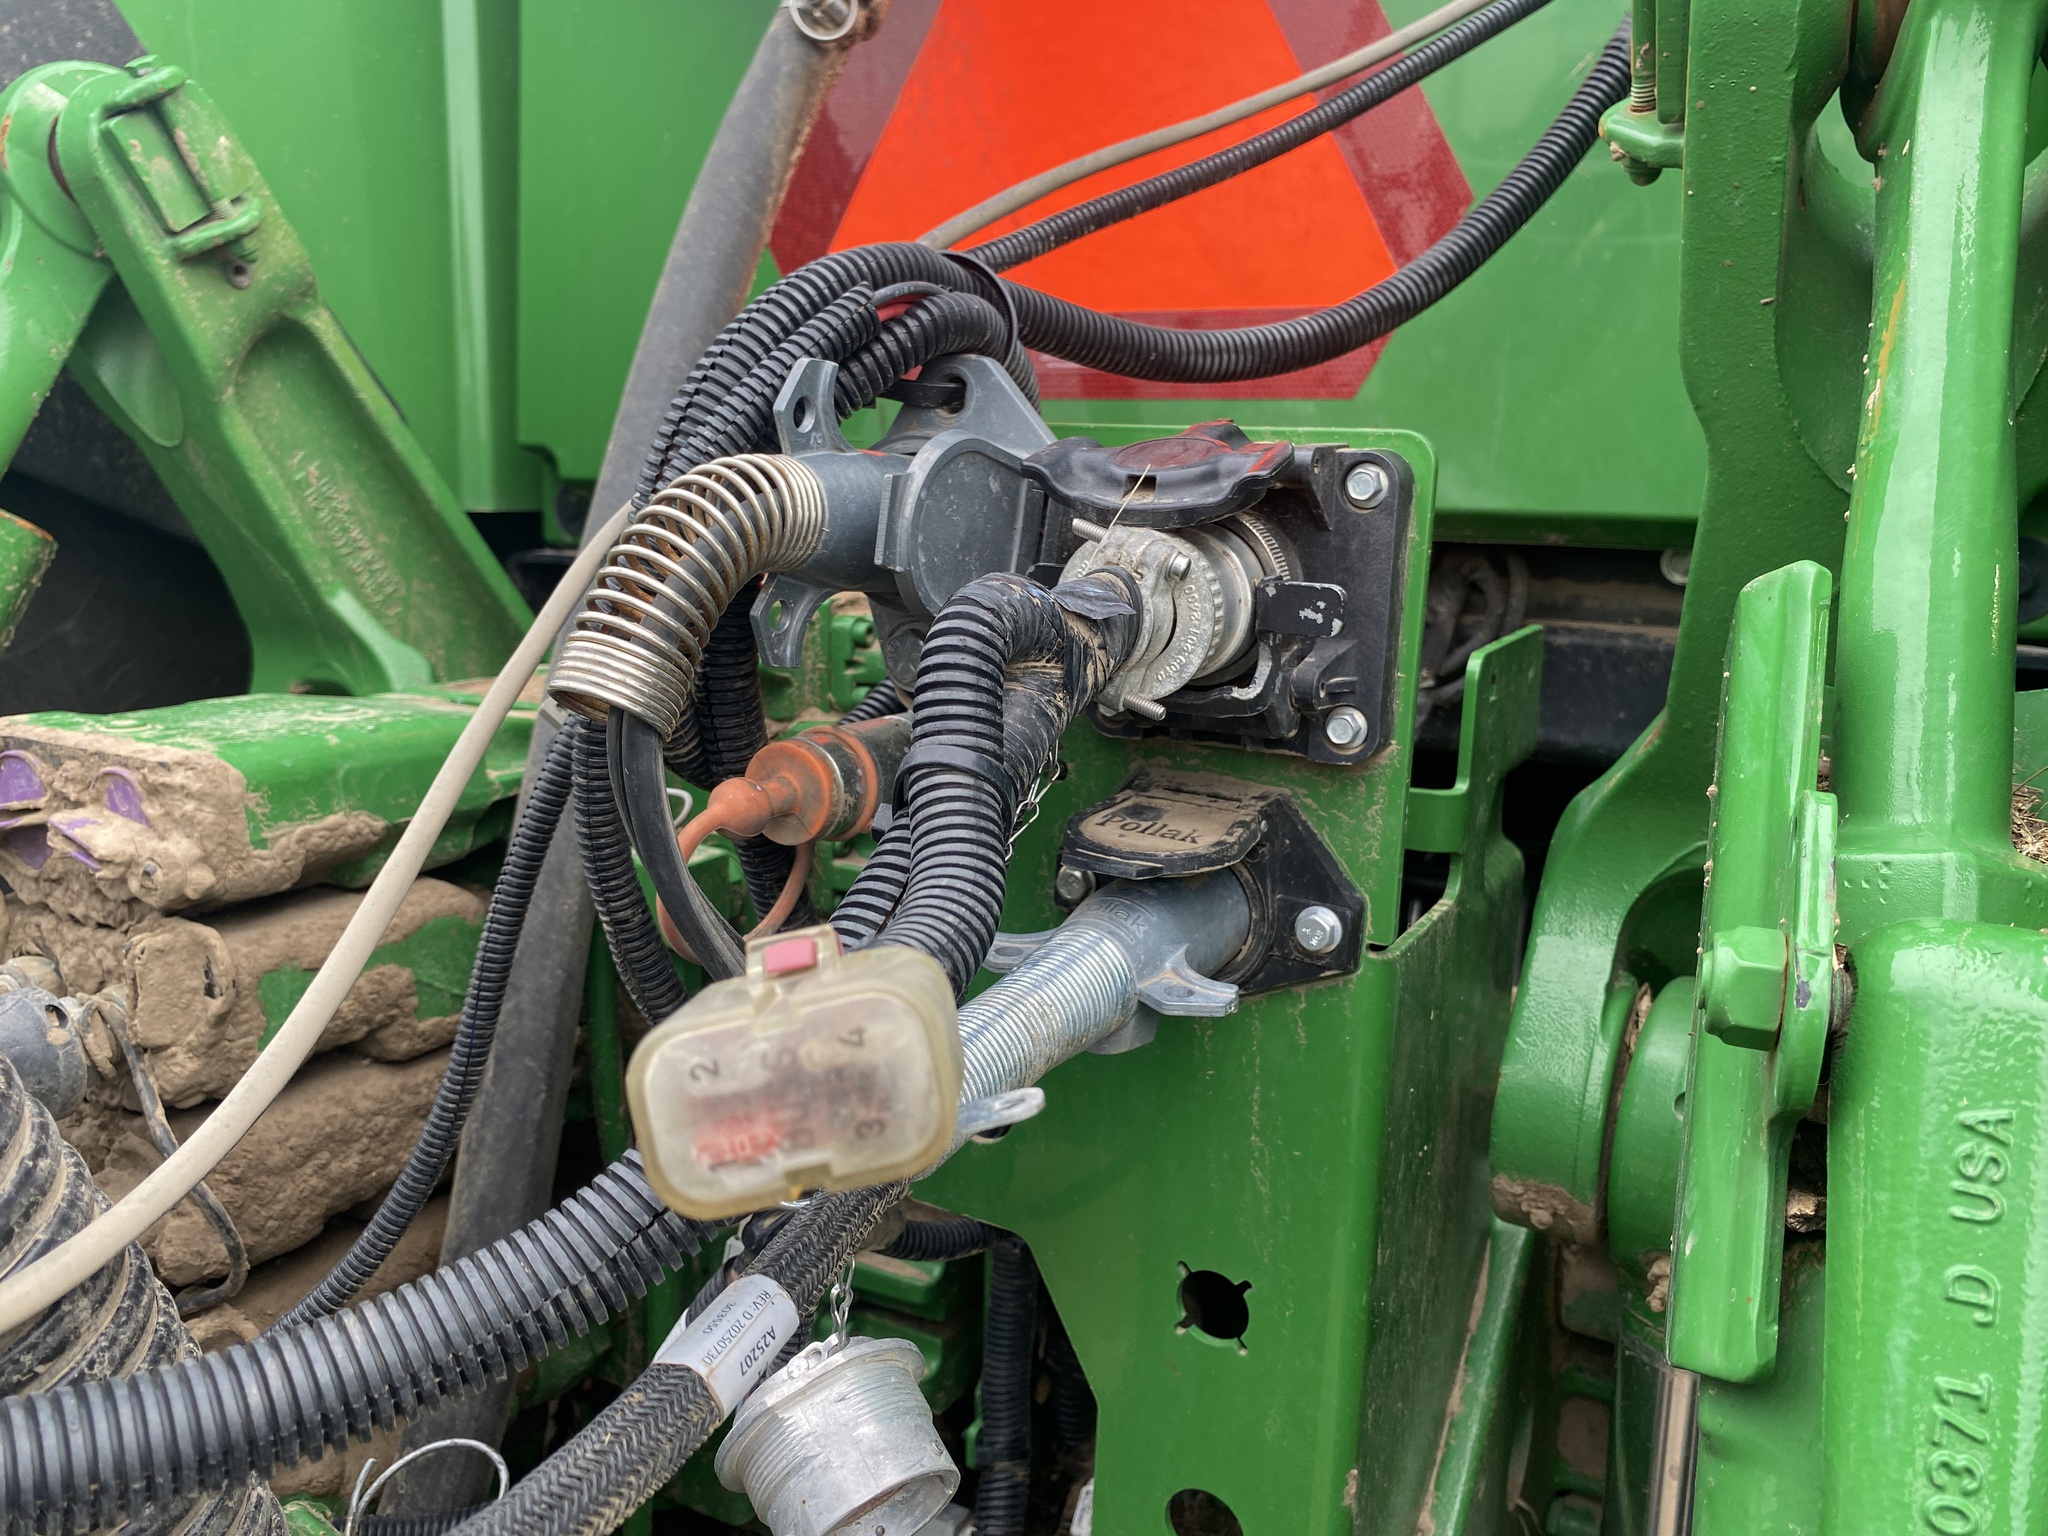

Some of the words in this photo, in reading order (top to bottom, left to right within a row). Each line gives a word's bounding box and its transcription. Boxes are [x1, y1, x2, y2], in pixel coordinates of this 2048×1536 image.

[1096, 812, 1203, 845] Pollak
[690, 1057, 720, 1083] 2
[1948, 1108, 2016, 1225] USA
[742, 1310, 754, 1321] D
[749, 1289, 772, 1312] REV:
[702, 1319, 746, 1366] 20250730
[739, 1325, 776, 1377] A25207
[1922, 1373, 1994, 1536] 0371
